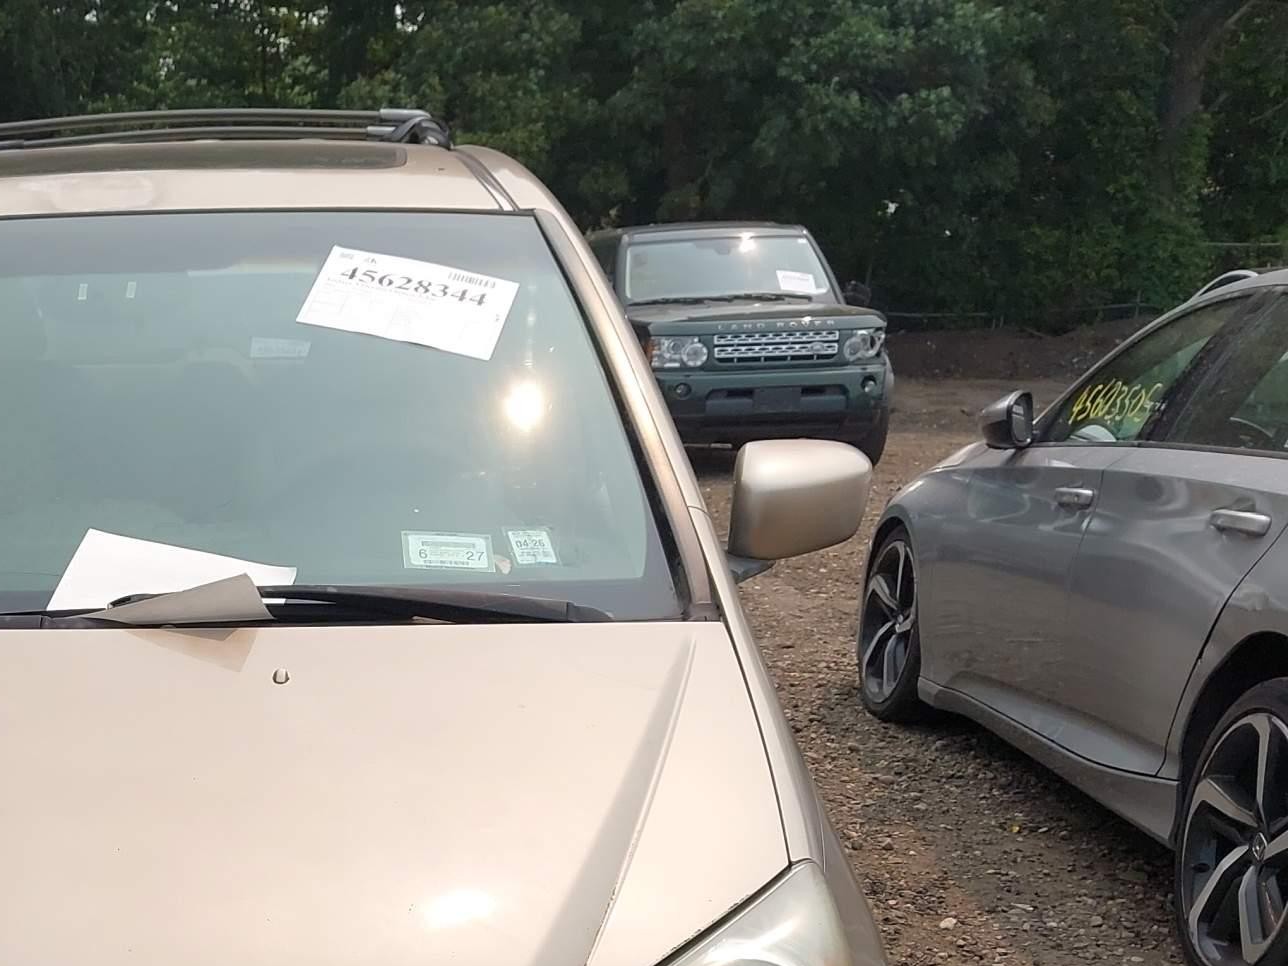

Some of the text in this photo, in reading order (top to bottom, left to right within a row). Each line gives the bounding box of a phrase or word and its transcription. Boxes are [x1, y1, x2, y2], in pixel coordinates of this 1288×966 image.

[341, 266, 488, 306] 45628344
[418, 549, 485, 561] 6 27
